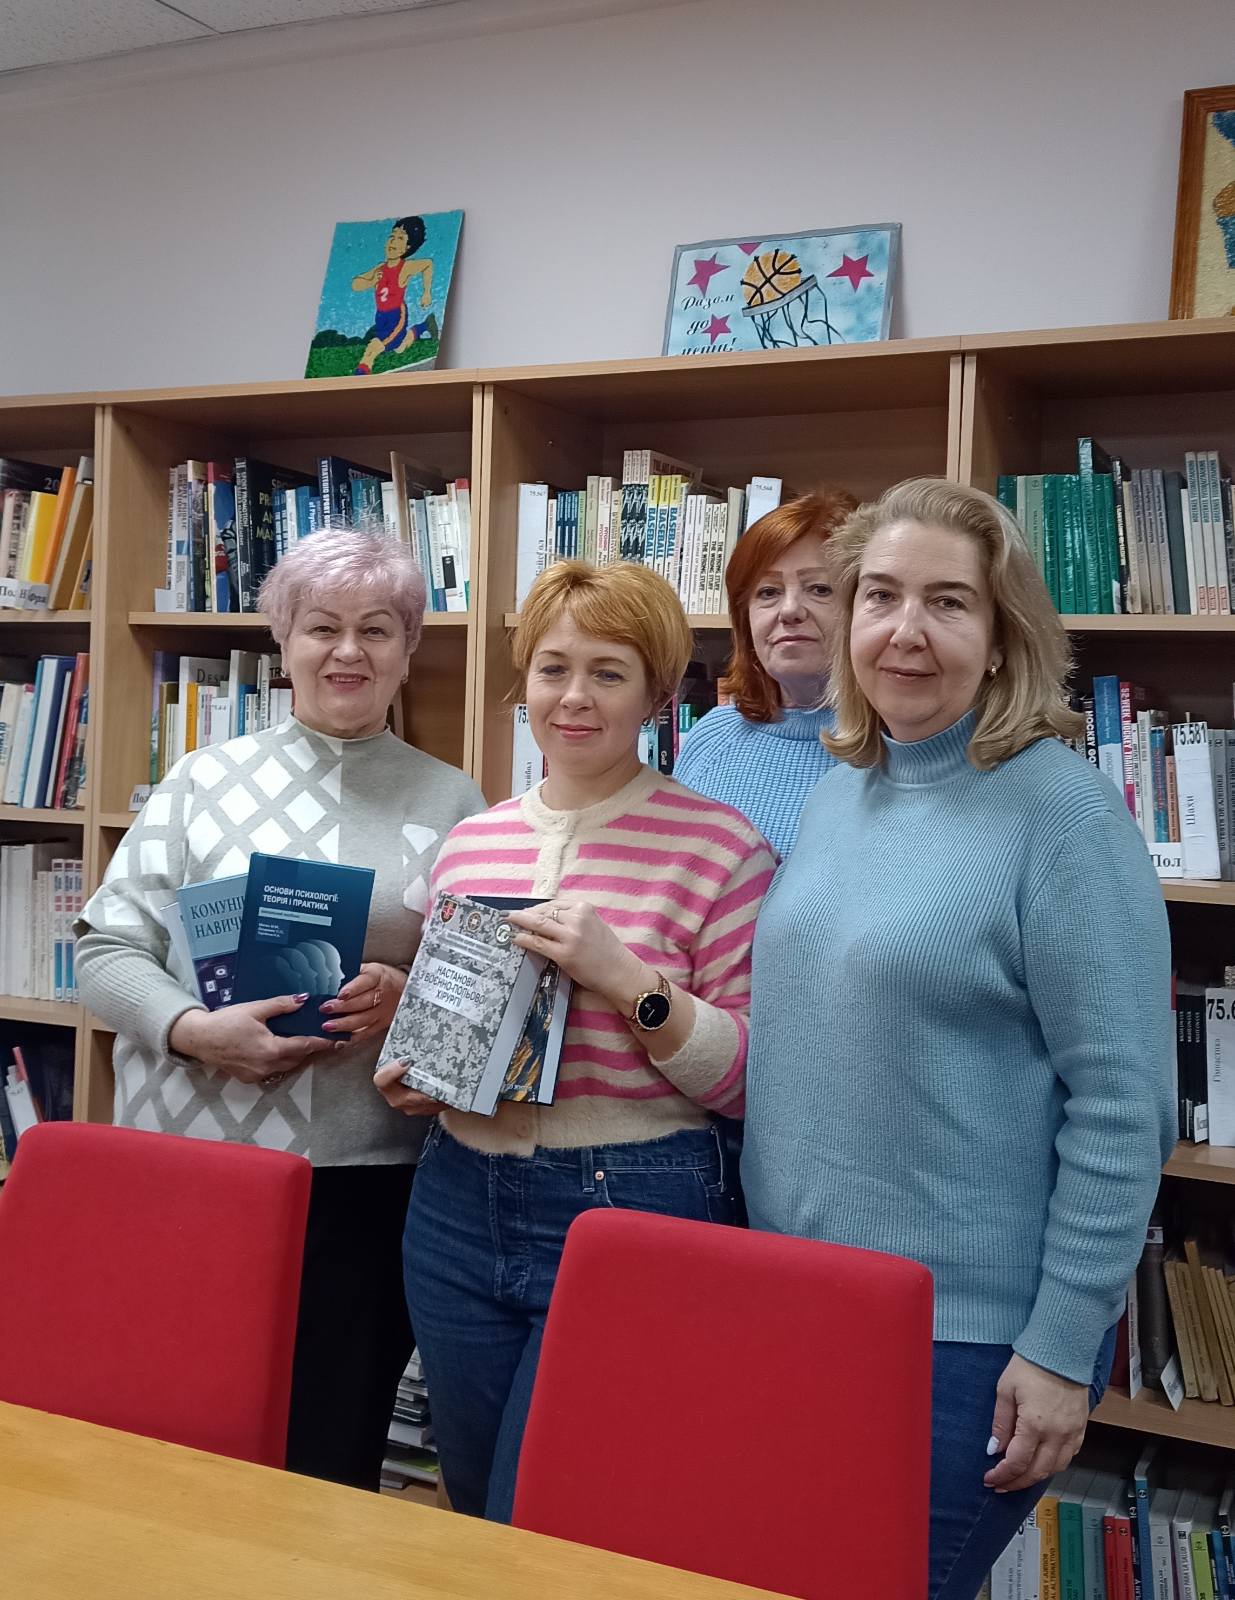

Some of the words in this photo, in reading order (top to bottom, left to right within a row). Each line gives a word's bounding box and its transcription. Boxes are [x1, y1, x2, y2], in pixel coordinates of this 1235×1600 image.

[381, 287, 389, 302] 2
[681, 295, 734, 311] Разом
[645, 508, 656, 558] BASEBALL
[656, 510, 667, 560] BASEBALL
[667, 507, 678, 558] BASEBALL
[518, 705, 528, 723] 75.
[1121, 687, 1131, 718] 52-WEEK
[1086, 711, 1095, 746] HOCKEY
[1122, 720, 1132, 748] HOCKEY
[1173, 724, 1207, 746] 75.581
[1124, 751, 1134, 784] TRAINING
[1186, 795, 1196, 825] Шахи
[263, 894, 288, 905] ТЕОРІЯ
[292, 899, 329, 911] ПРАКТИКА
[264, 885, 294, 897] ОСНОВИ
[437, 964, 477, 989] НАСТАНОВИ
[435, 988, 463, 1007] ХІРУРГІЇ
[1212, 1038, 1222, 1082] Гімнастика
